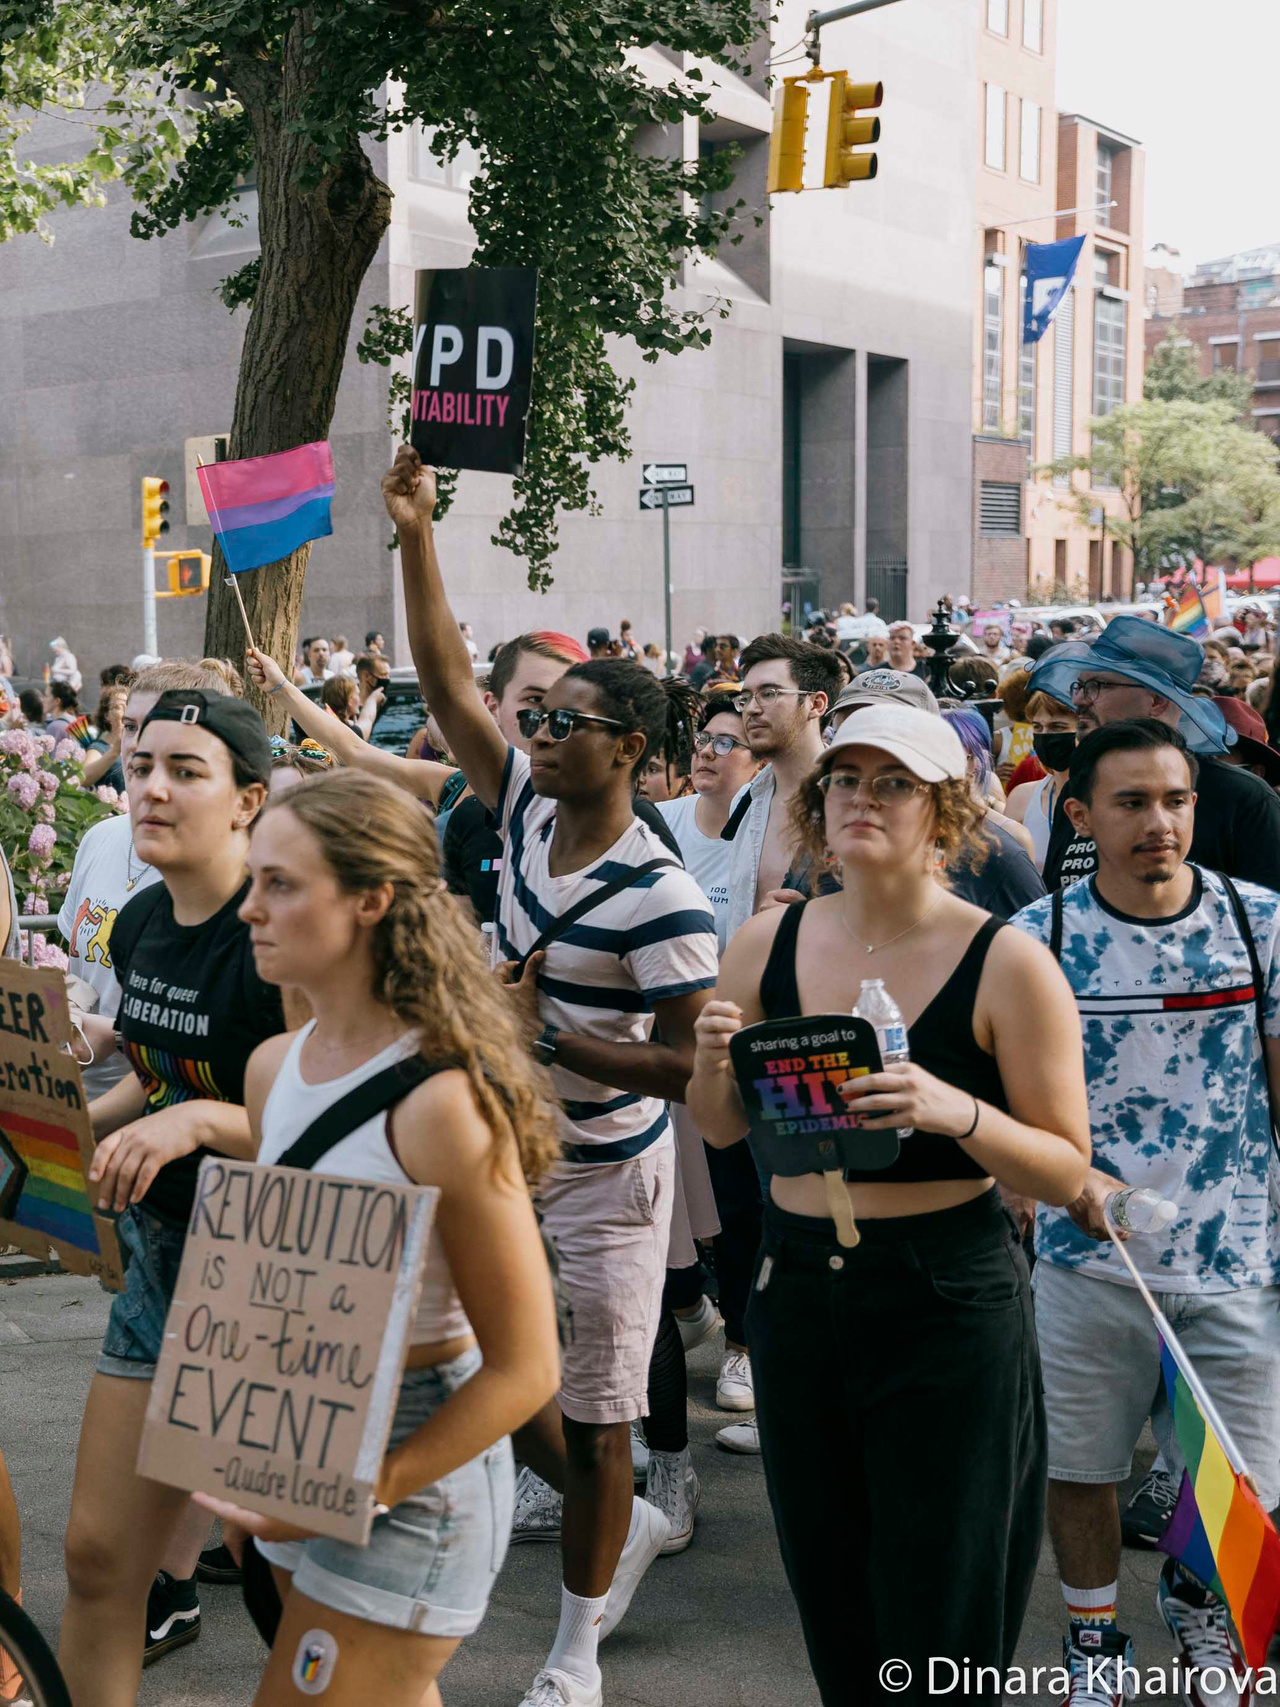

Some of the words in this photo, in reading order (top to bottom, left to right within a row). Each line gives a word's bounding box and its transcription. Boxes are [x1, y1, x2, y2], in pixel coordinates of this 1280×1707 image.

[1061, 857, 1095, 871] PRO
[1060, 874, 1088, 888] PR
[149, 977, 168, 995] for
[166, 986, 199, 1003] queer
[123, 993, 210, 1036] LIBERATION
[750, 1037, 800, 1052] sharing
[800, 1036, 809, 1046] a
[811, 1030, 839, 1047] goal
[841, 1029, 856, 1040] to
[764, 1057, 806, 1075] END
[808, 1051, 850, 1069] THE
[191, 1164, 422, 1273] REVOLUTION
[250, 1262, 317, 1310] NOT
[330, 1284, 355, 1314] a
[168, 1364, 355, 1469] EVENT
